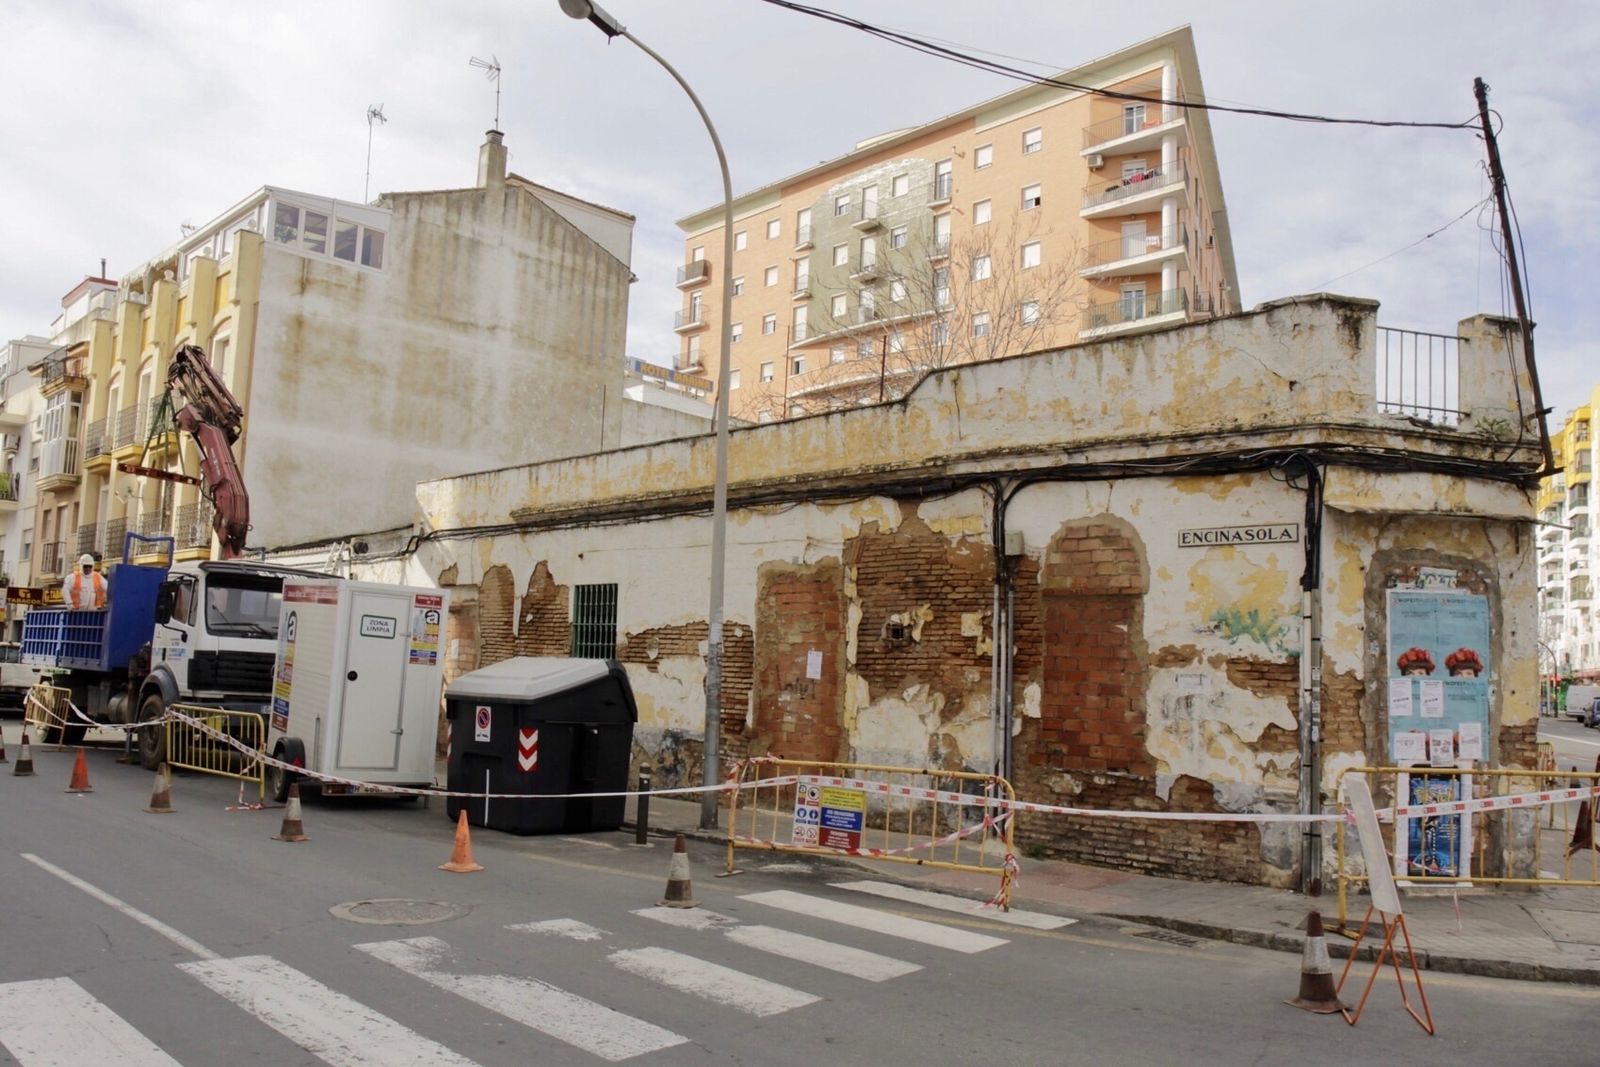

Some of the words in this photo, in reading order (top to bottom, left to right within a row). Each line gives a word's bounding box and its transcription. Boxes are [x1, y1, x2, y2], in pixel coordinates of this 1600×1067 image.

[640, 362, 670, 380] HOTEL
[1182, 528, 1293, 544] ENCINASOLA
[7, 597, 41, 605] TABACOS
[369, 619, 389, 627] ZONA
